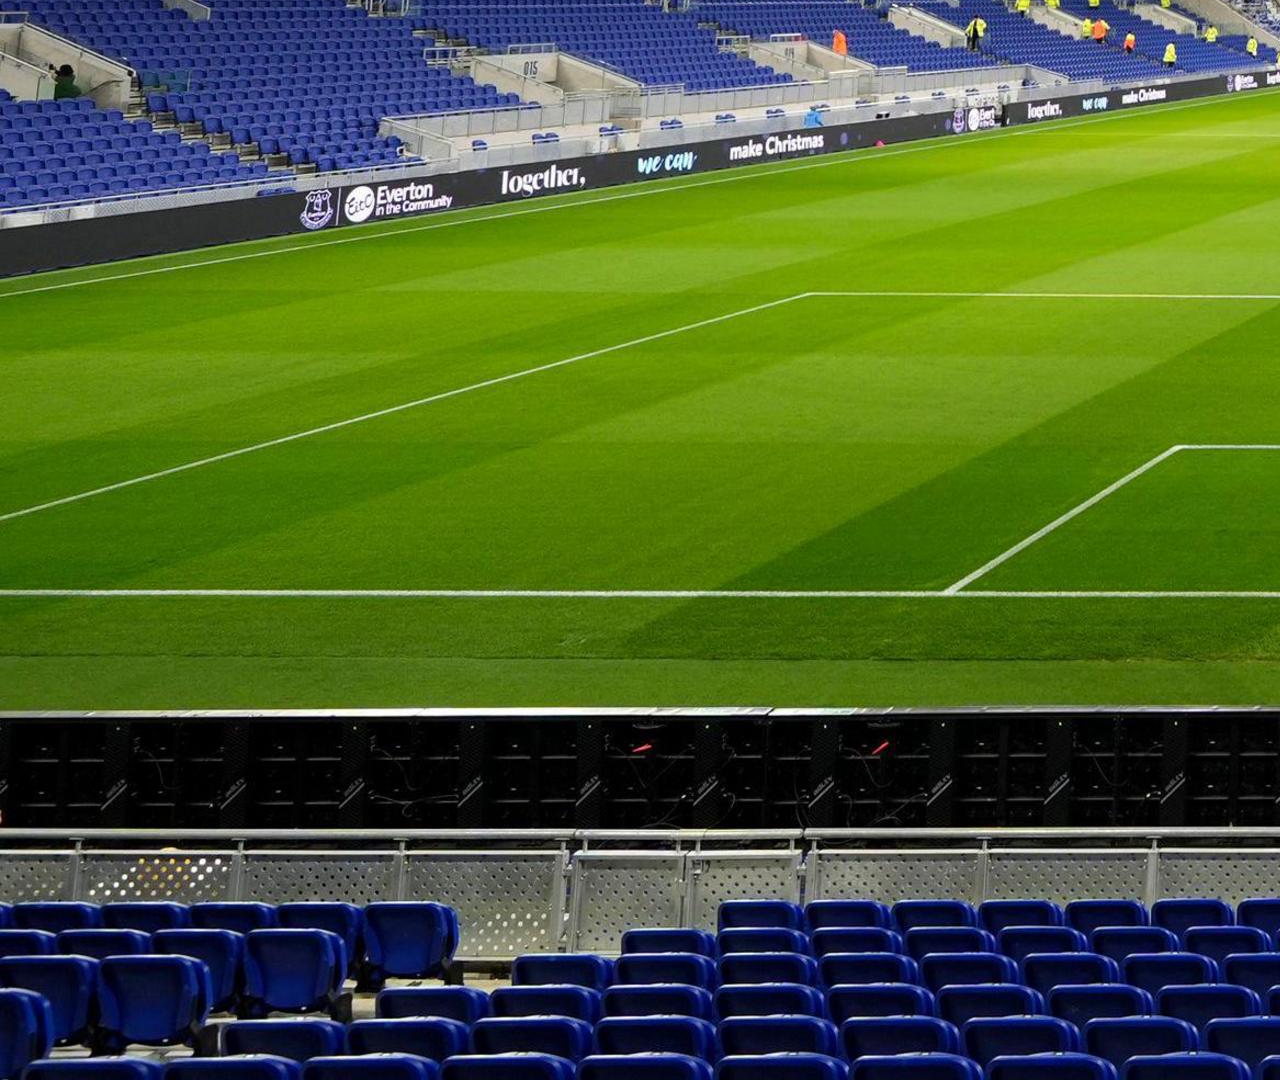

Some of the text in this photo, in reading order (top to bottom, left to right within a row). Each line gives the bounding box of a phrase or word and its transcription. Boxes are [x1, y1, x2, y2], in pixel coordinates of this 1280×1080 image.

[523, 60, 539, 76] 015
[730, 133, 825, 160] make Christmas
[637, 151, 698, 175] we can
[501, 164, 586, 198] Together,
[376, 182, 433, 205] Everton
[375, 195, 453, 216] in the Community
